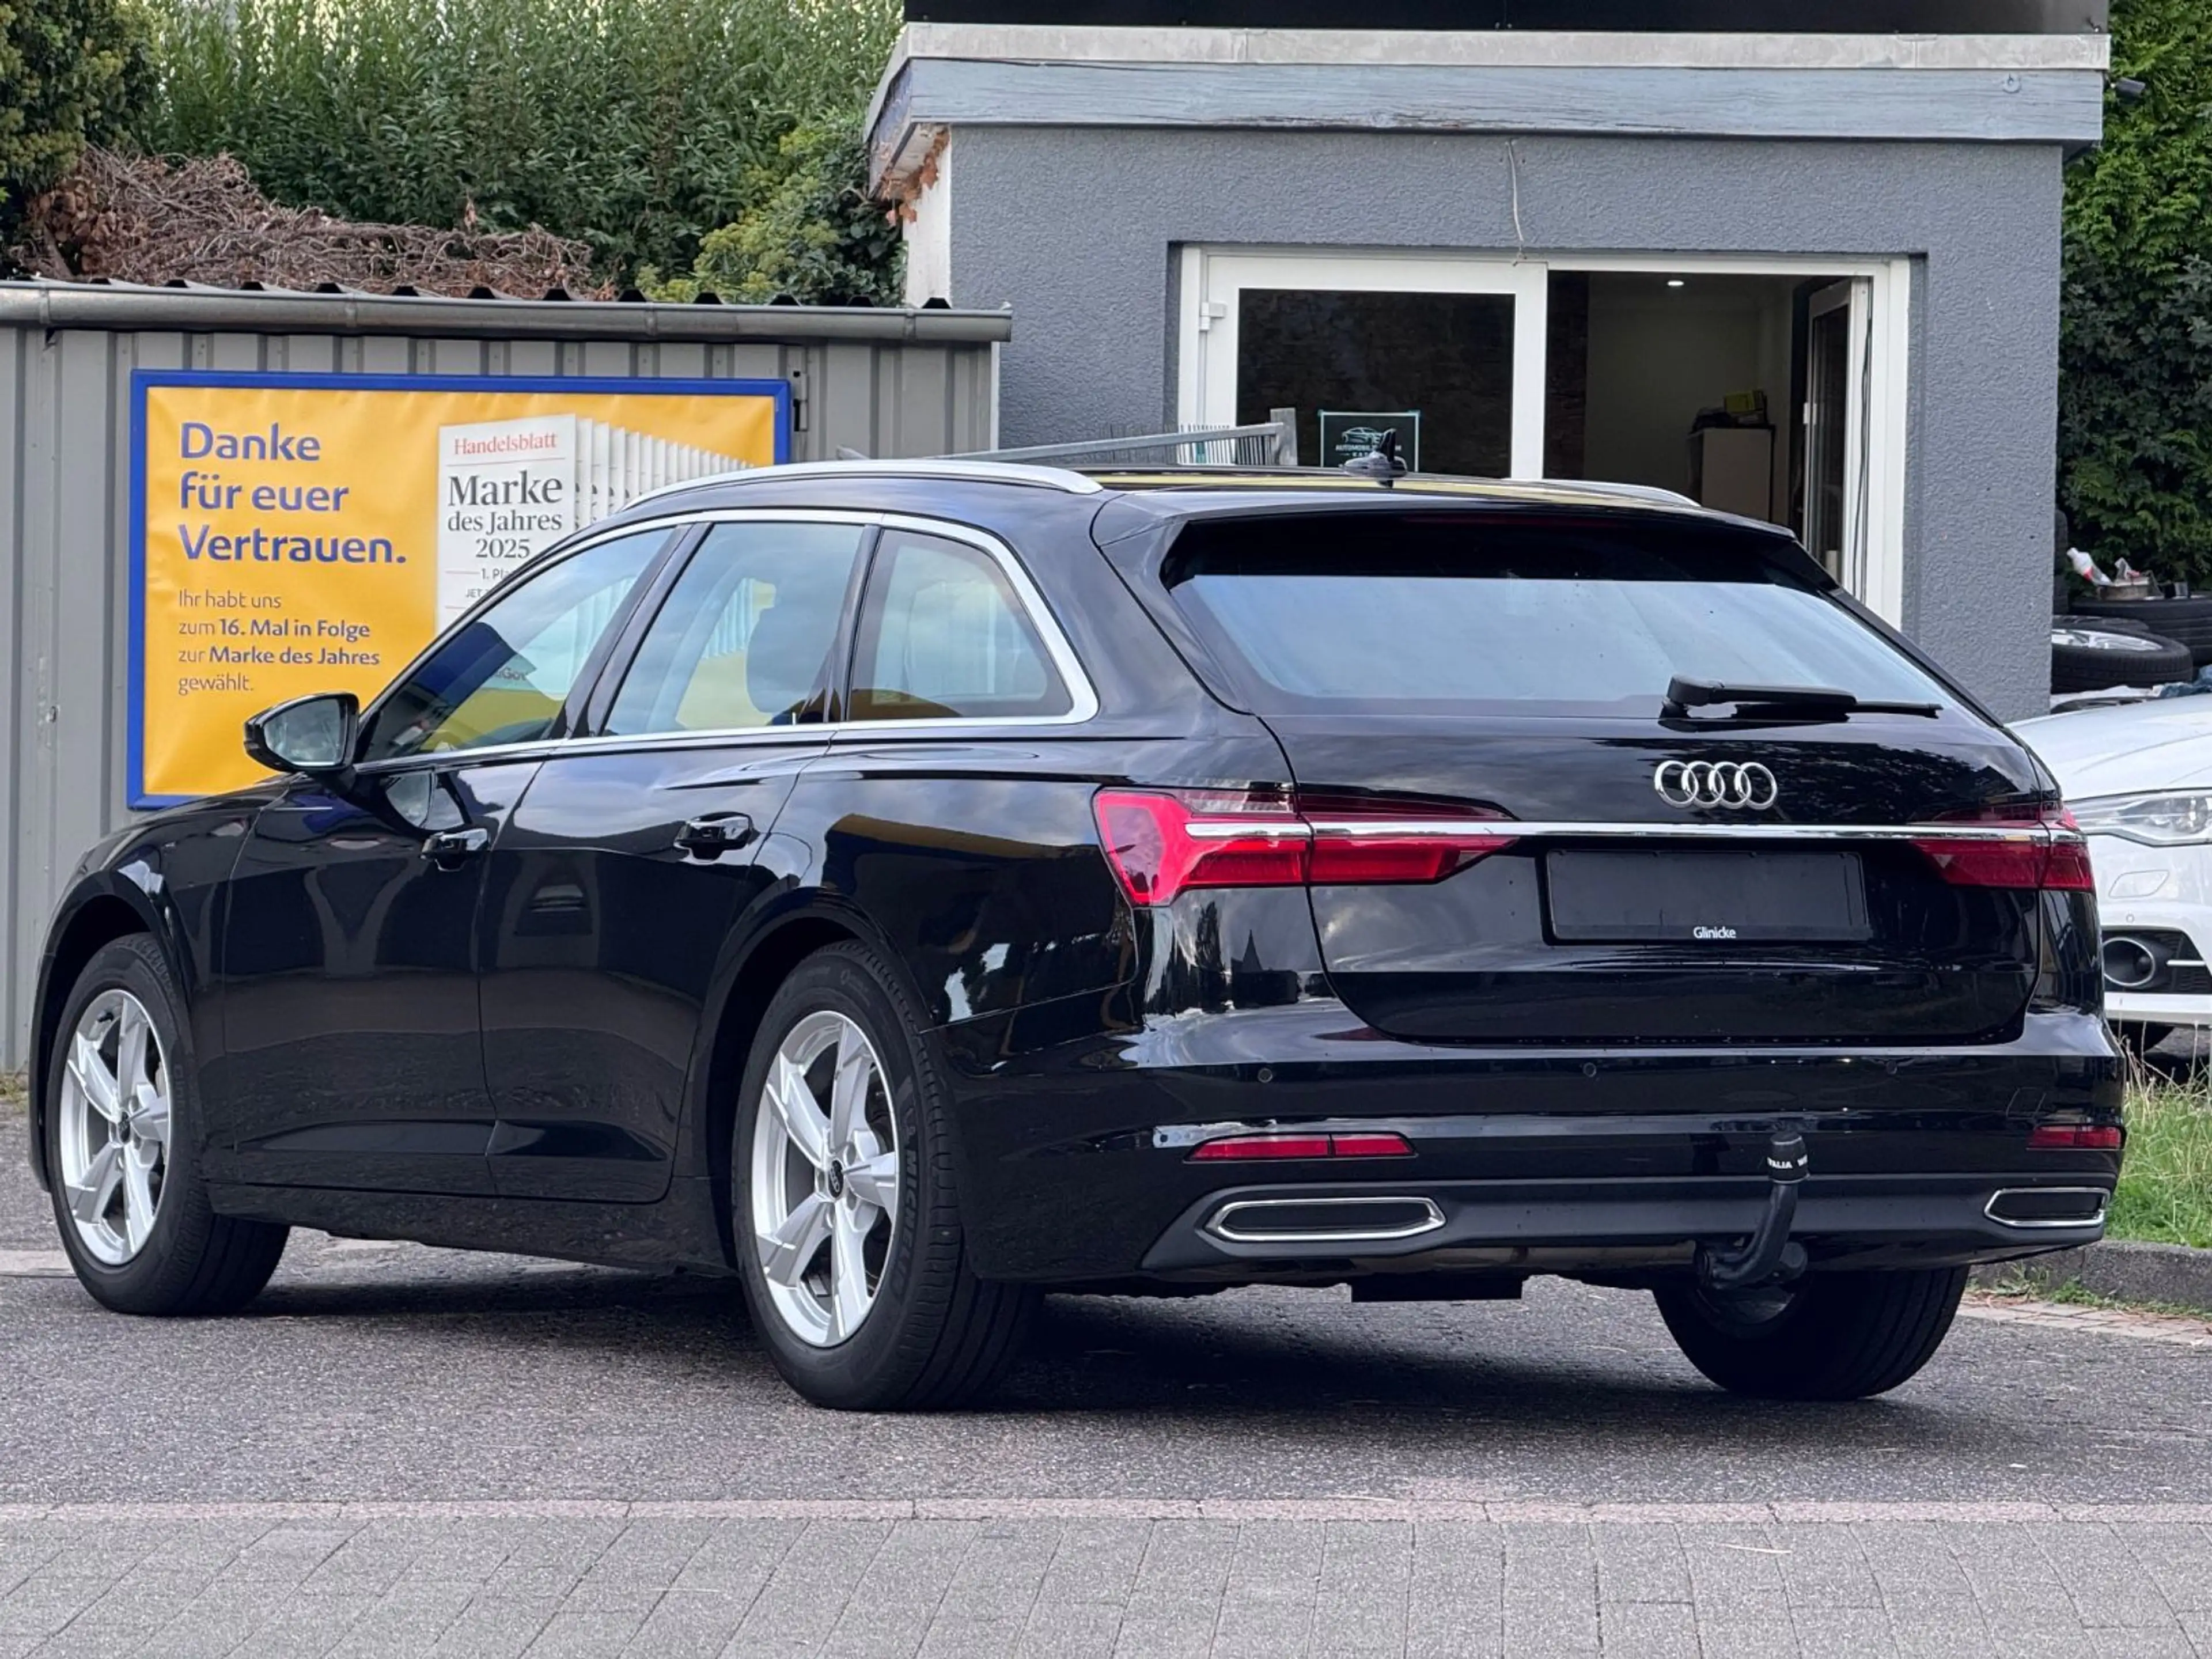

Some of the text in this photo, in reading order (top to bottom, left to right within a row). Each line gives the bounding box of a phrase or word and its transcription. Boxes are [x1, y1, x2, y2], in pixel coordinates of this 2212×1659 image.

[181, 422, 321, 462] Danke
[453, 432, 558, 456] Handelsblatt
[180, 471, 350, 512] für euer
[448, 469, 563, 507] Marke
[448, 509, 563, 535] des Jahres
[179, 524, 407, 565] Vertrauen.
[475, 538, 531, 559] 2025
[482, 567, 490, 579] 1.
[179, 589, 282, 609] Ihr habt uns
[179, 618, 370, 643] zum 16. Mal in Folge
[179, 645, 380, 666] zur Marke des Jahres
[178, 672, 254, 696] gewählt.
[1693, 926, 1736, 939] Glinicke
